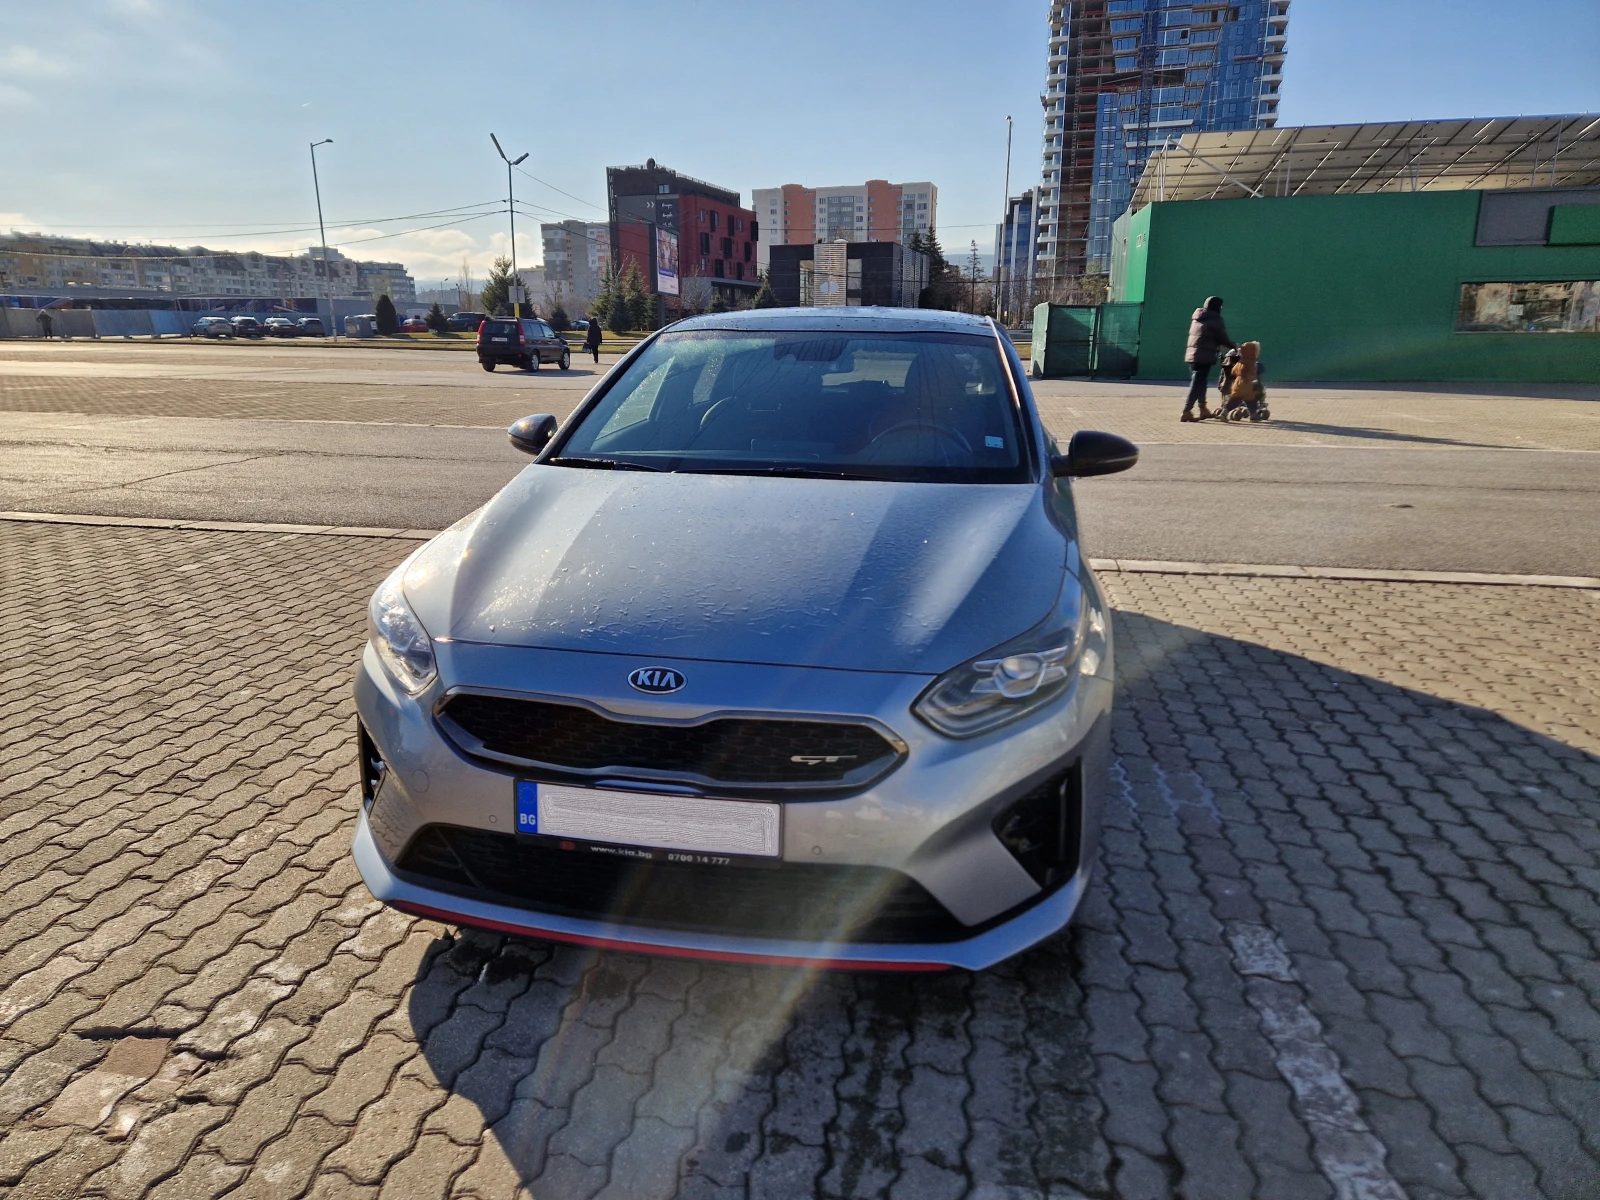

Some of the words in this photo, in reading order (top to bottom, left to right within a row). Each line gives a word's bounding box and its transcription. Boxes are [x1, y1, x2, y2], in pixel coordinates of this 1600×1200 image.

[637, 670, 676, 688] KIA
[519, 813, 536, 826] BG
[590, 845, 652, 860] www.kia.bg
[696, 855, 708, 864] 14
[711, 856, 731, 866] 777
